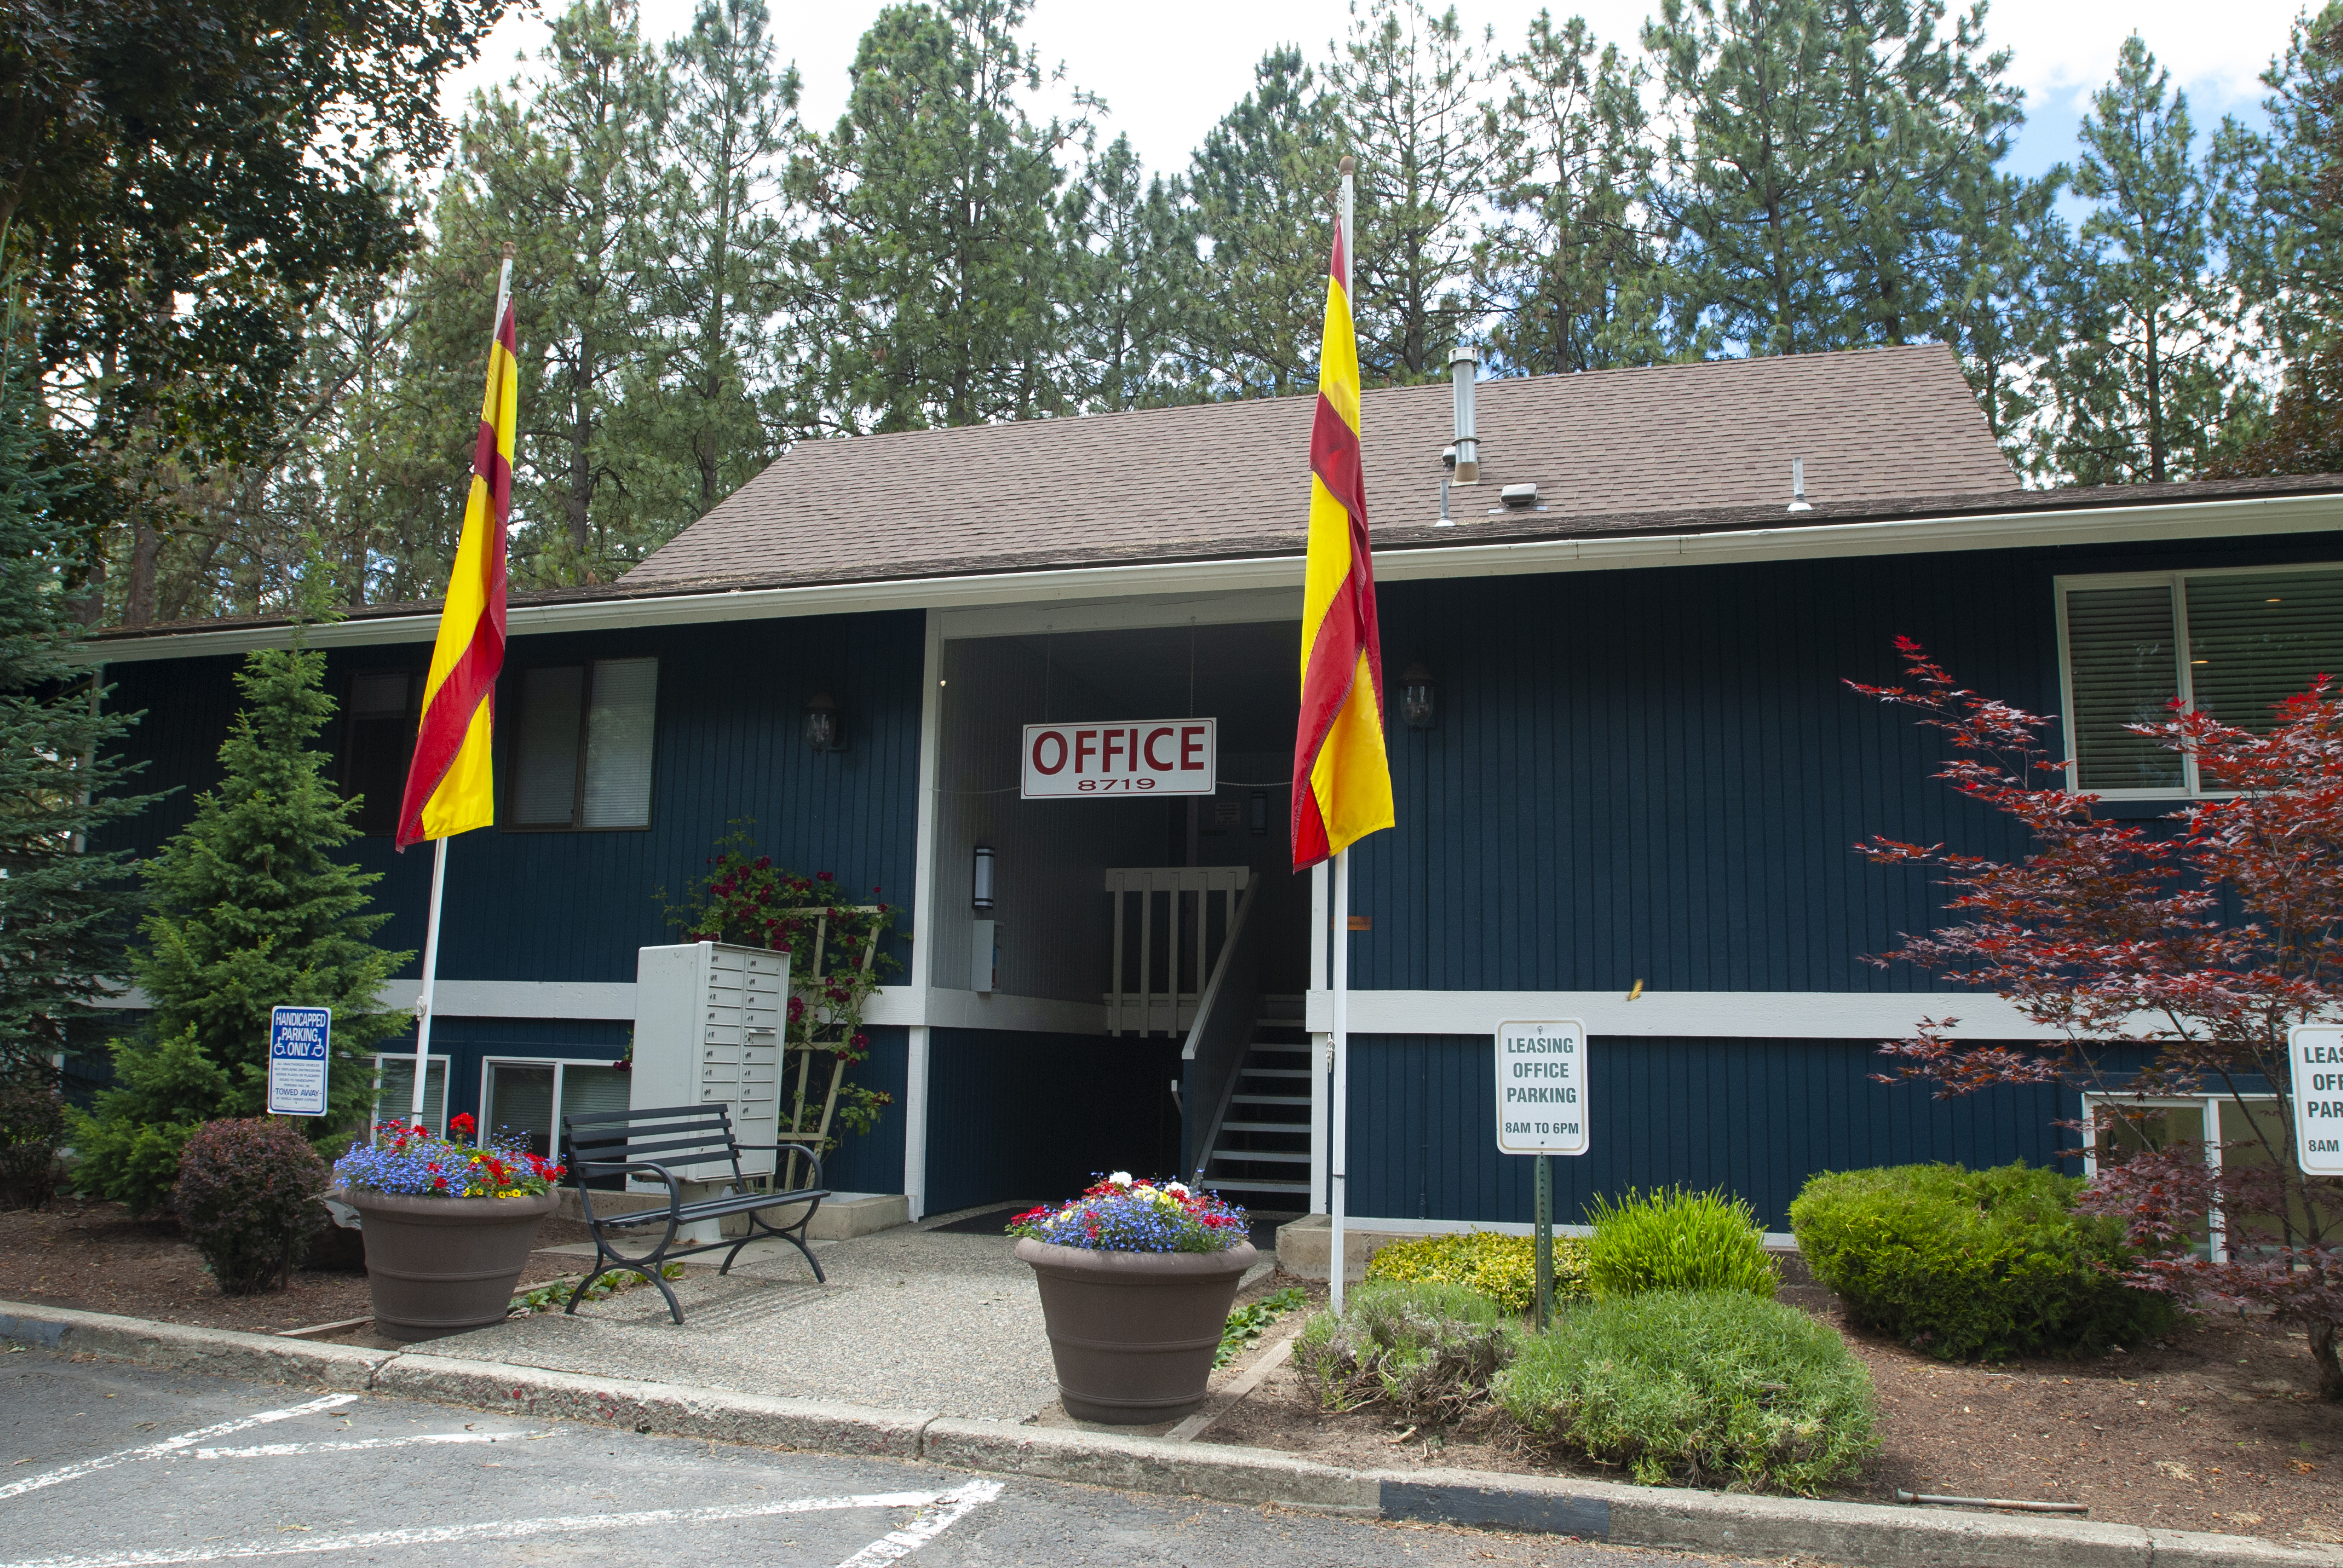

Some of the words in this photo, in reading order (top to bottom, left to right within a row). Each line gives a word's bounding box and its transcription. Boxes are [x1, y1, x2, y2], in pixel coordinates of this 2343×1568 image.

[1032, 726, 1205, 776] OFFICE
[1077, 778, 1156, 791] 8719
[275, 1012, 326, 1027] HANDICAPPED
[281, 1027, 318, 1042] PARKING
[287, 1042, 311, 1056] ONLY
[1507, 1037, 1573, 1053] LEASING
[1513, 1062, 1569, 1078] OFFICE
[1507, 1087, 1576, 1103] PARKING
[1505, 1122, 1531, 1133] 8AM
[1535, 1122, 1549, 1134] TO
[1553, 1123, 1579, 1134] 6PM
[2308, 1140, 2339, 1152] 8AM
